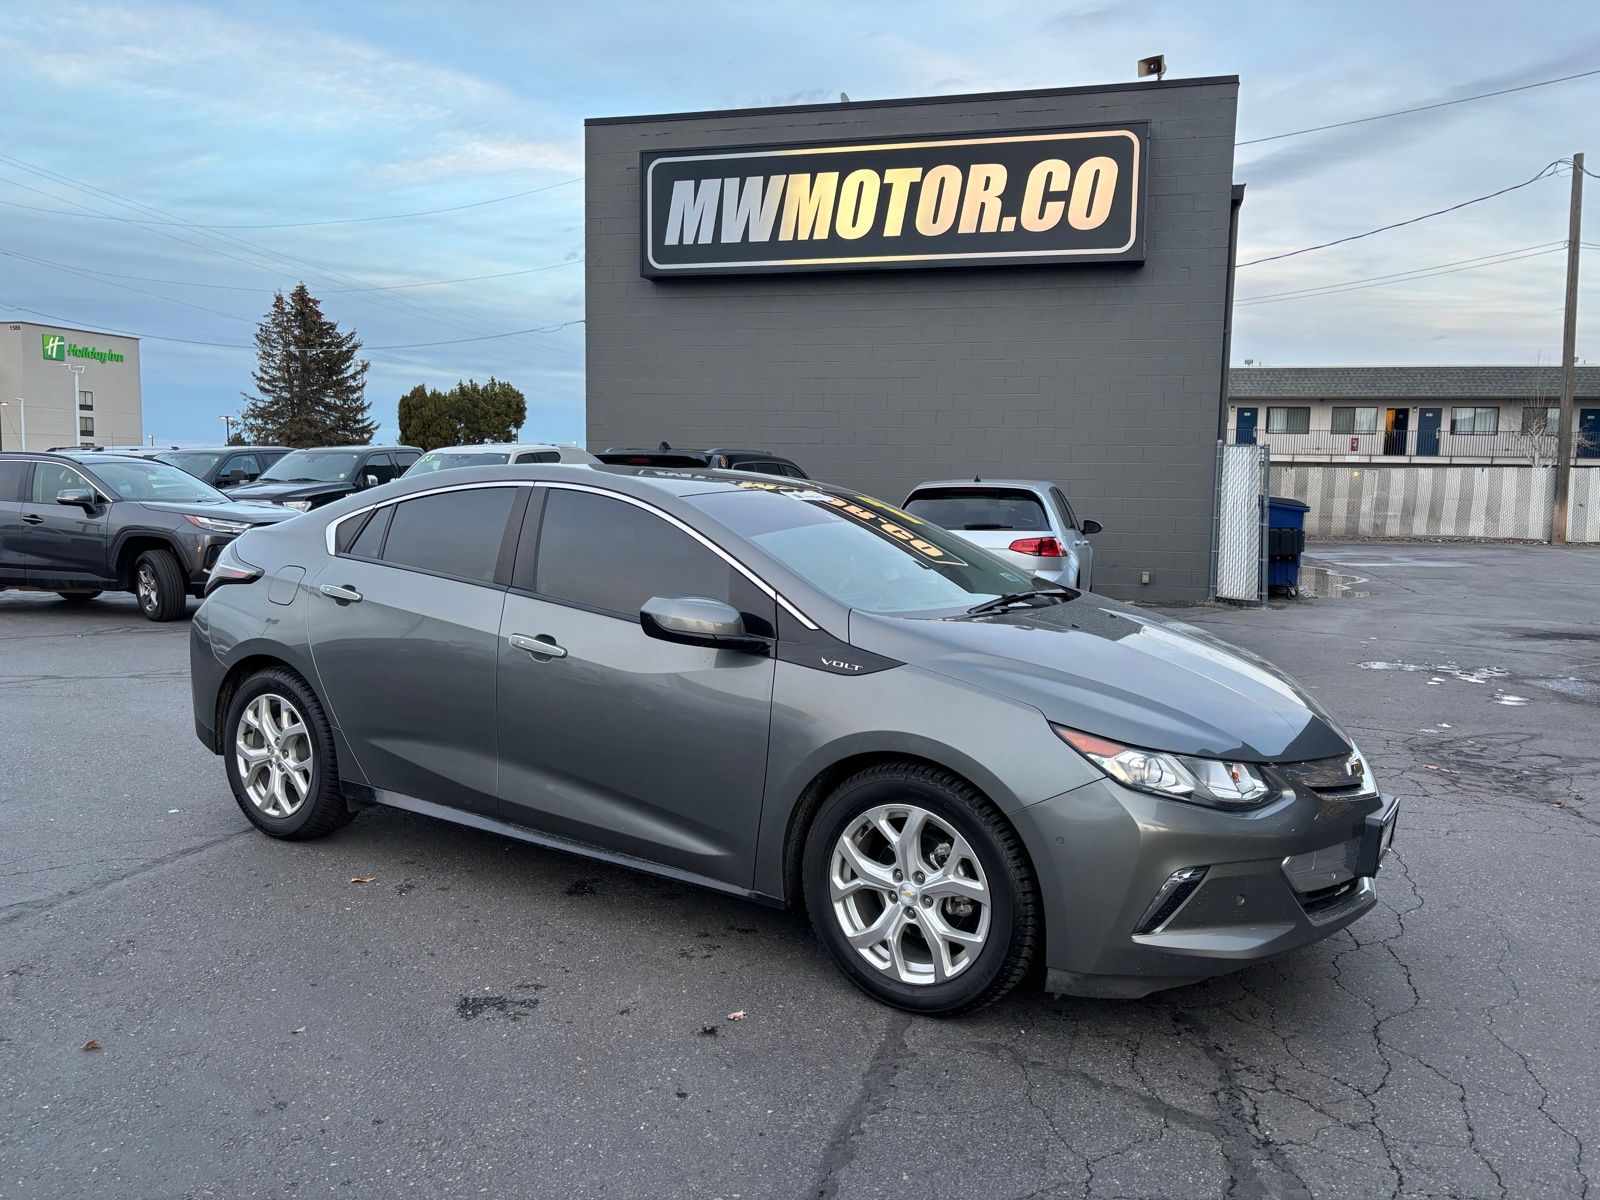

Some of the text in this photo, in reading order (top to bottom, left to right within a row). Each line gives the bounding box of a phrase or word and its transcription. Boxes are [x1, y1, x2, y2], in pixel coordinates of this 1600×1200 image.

[664, 156, 1119, 246] MWMOTOR.CO
[67, 343, 124, 364] Holiday Inn
[821, 656, 863, 671] VOLT
